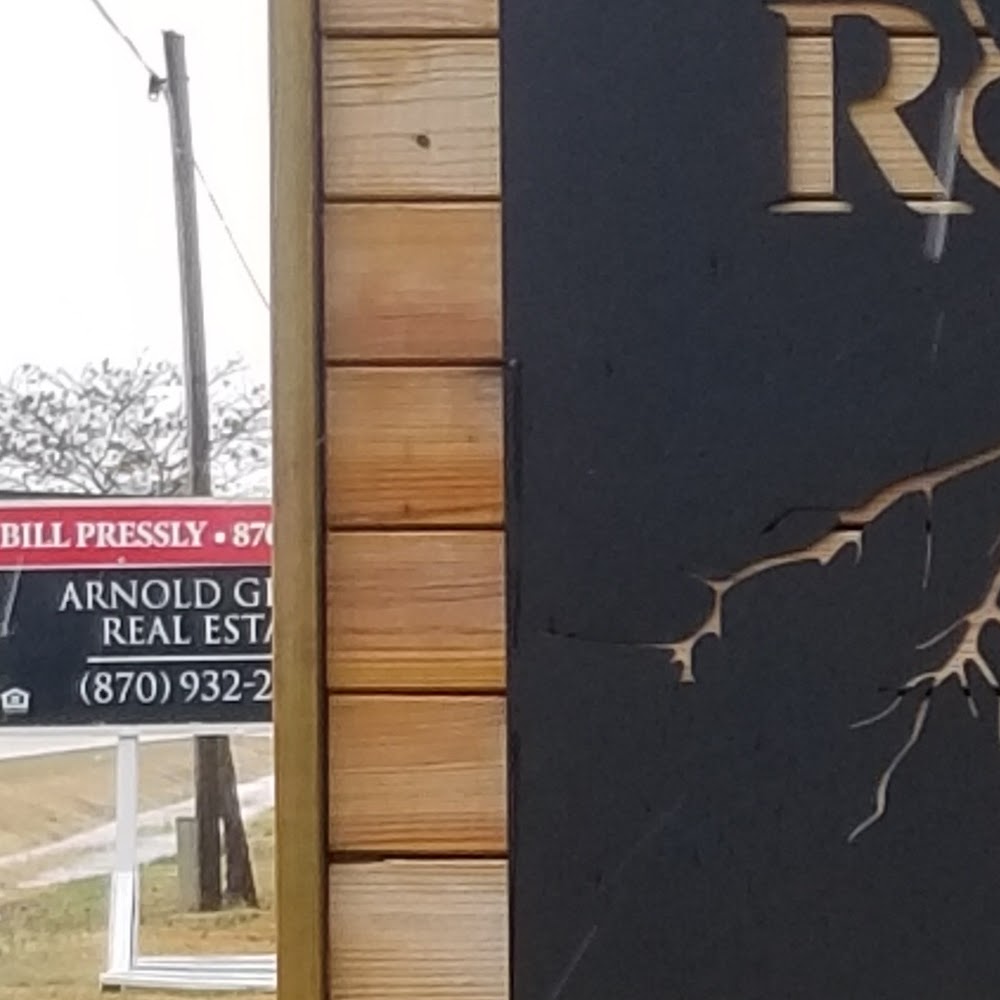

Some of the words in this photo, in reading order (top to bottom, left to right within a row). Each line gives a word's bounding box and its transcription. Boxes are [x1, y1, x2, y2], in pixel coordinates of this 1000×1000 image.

[0, 521, 71, 549] BILL
[76, 520, 208, 548] PRESSLY
[58, 578, 222, 611] ARNOLD
[103, 615, 191, 645] REAL
[80, 671, 171, 705] (870)
